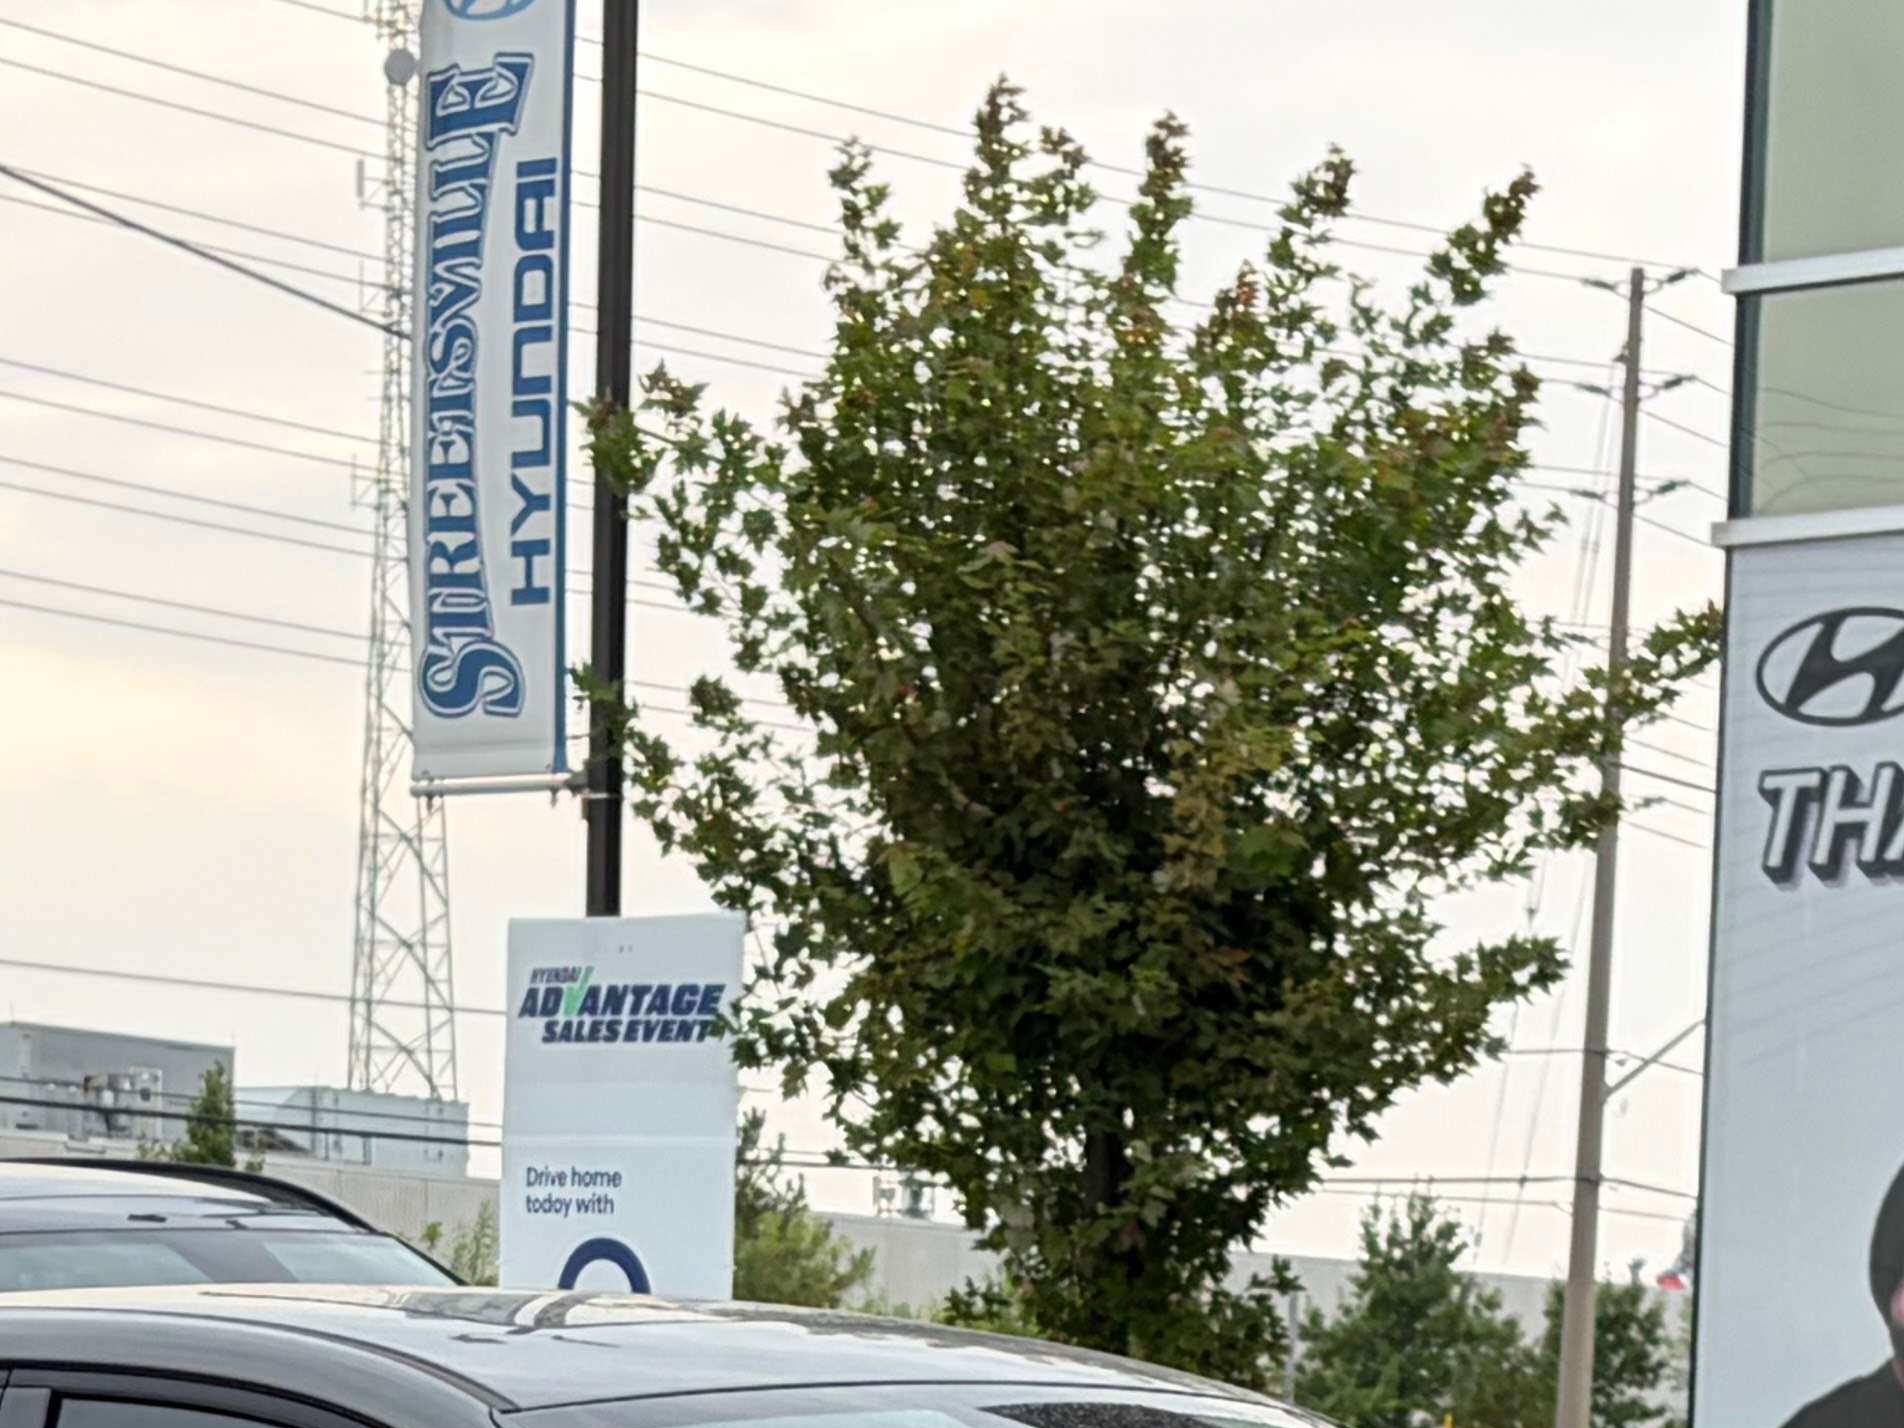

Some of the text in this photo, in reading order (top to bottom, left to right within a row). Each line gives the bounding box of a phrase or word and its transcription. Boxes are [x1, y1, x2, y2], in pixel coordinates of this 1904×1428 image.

[420, 52, 534, 717] STREETSVILLE
[511, 157, 557, 606] HYUNDAI
[518, 967, 726, 1018] ADVANTAGE
[541, 1019, 712, 1043] SALES EVENT
[526, 1165, 622, 1188] Drive home
[526, 1193, 614, 1218] today with
